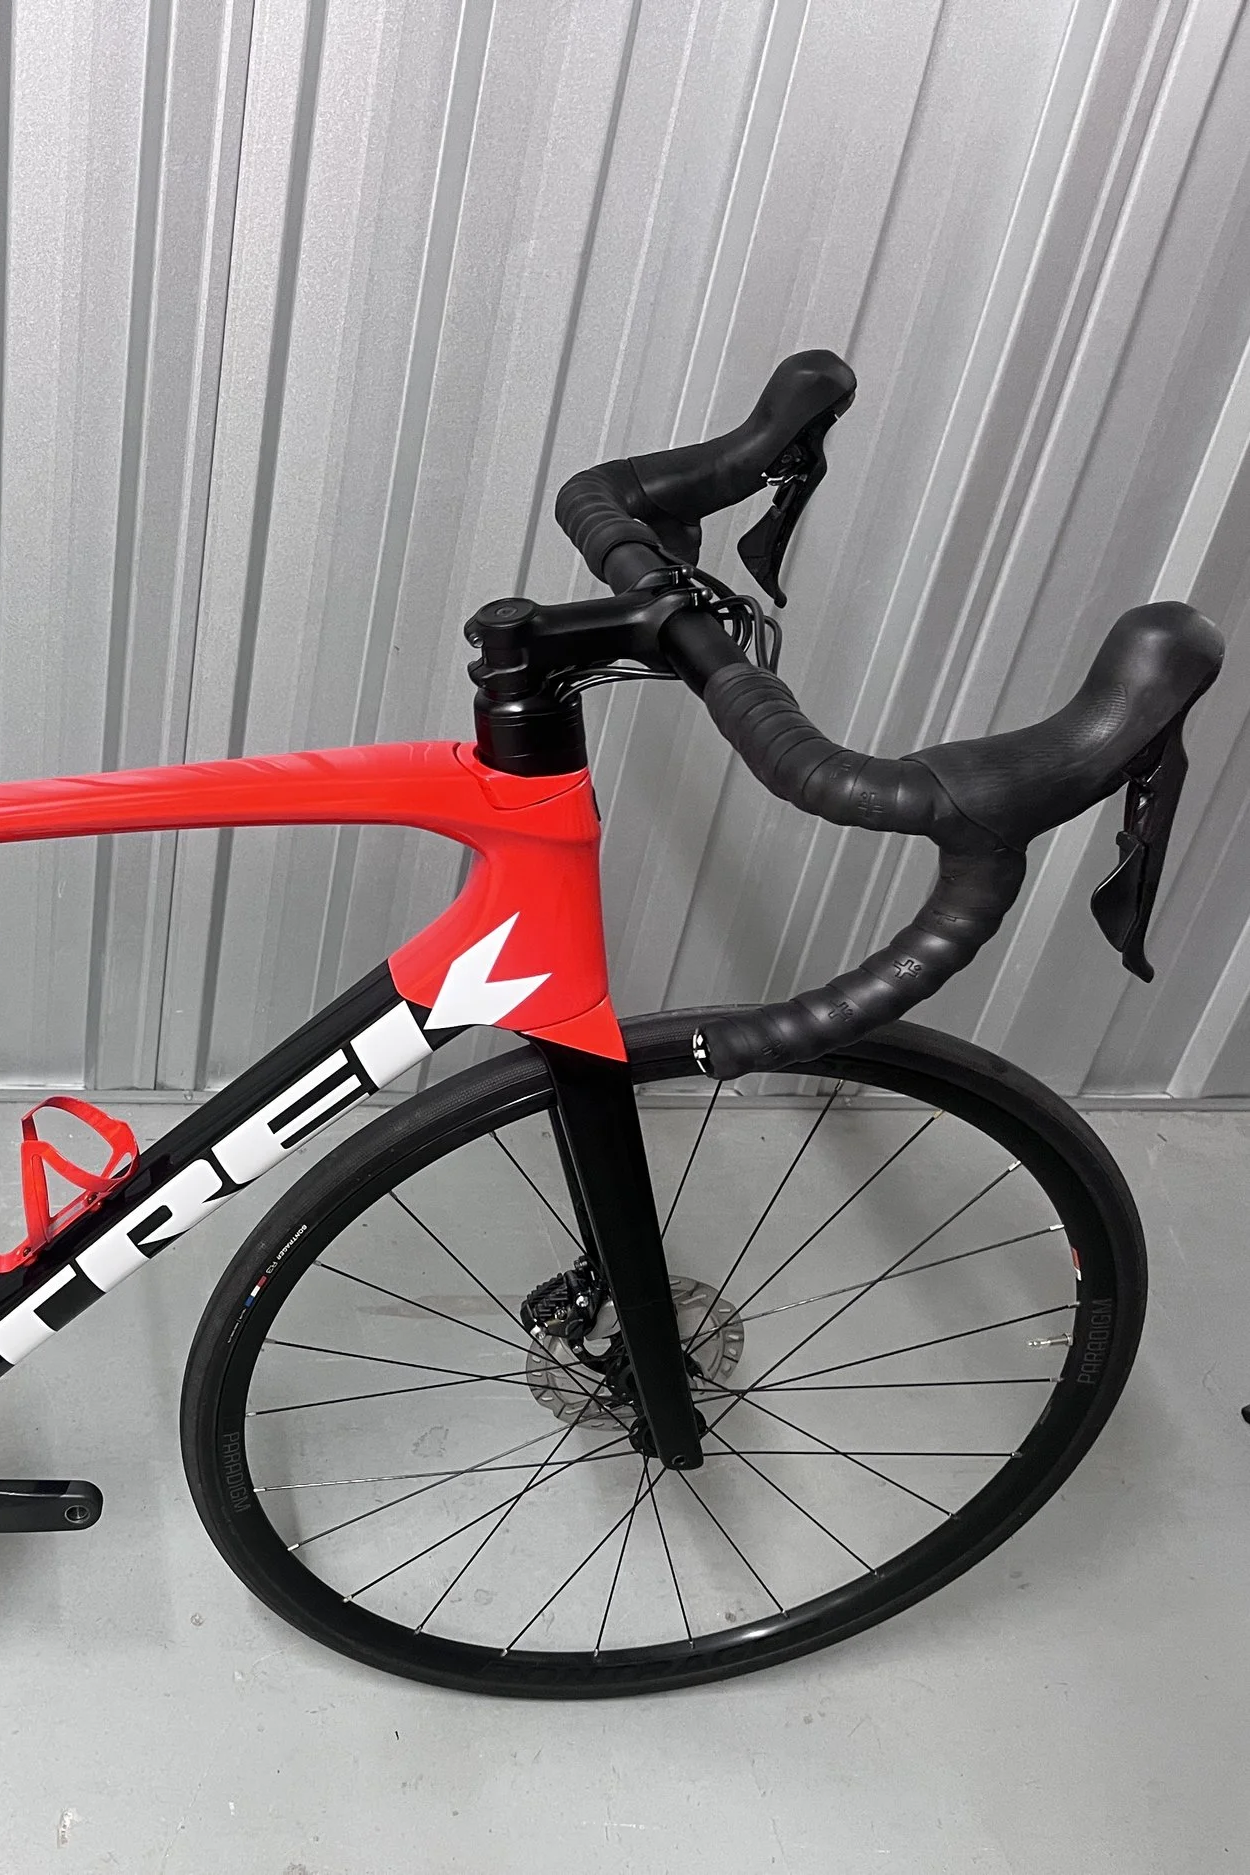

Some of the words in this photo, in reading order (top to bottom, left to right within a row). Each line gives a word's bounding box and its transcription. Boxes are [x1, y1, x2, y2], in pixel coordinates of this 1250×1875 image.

[276, 1224, 308, 1261] BONTRAGER
[1076, 1299, 1112, 1385] PARADIGM
[222, 1431, 251, 1513] PARADIGM
